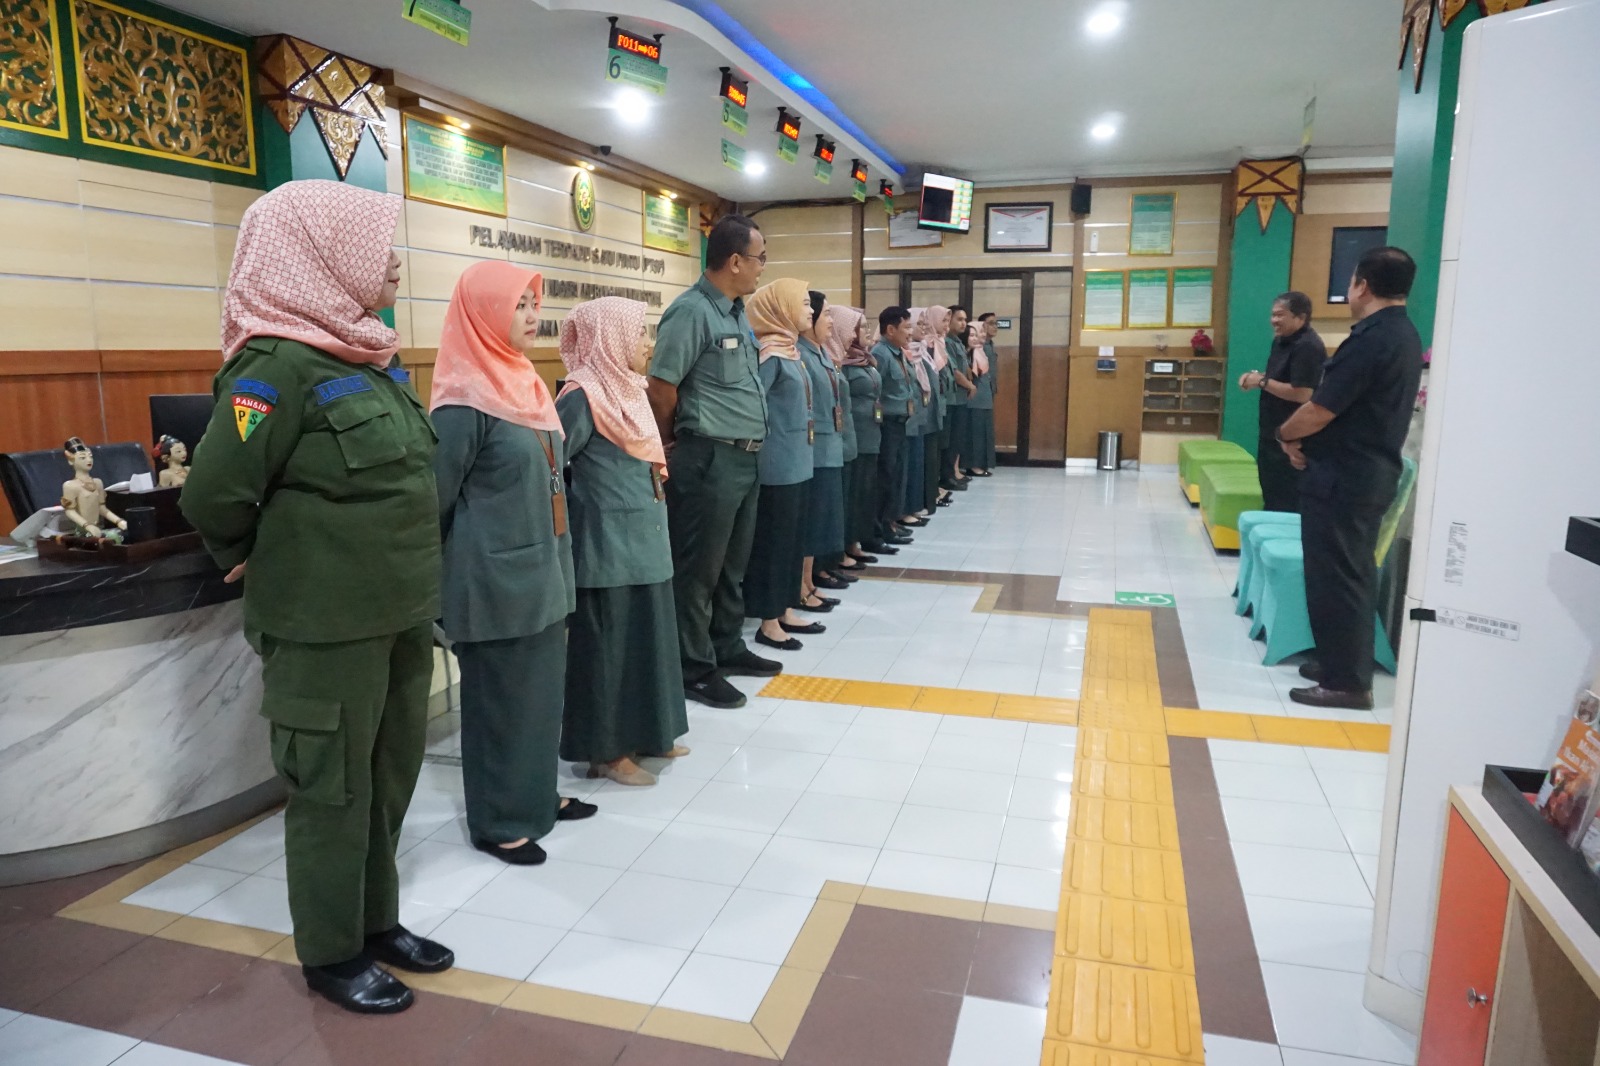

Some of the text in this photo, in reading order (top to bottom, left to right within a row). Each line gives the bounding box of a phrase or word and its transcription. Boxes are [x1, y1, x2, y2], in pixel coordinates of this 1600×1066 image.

[617, 34, 659, 59] F011 06
[609, 54, 621, 79] 6
[723, 104, 730, 123] 5
[470, 225, 541, 255] PELAYANAN
[235, 397, 267, 412] PANSID
[238, 410, 258, 425] P S
